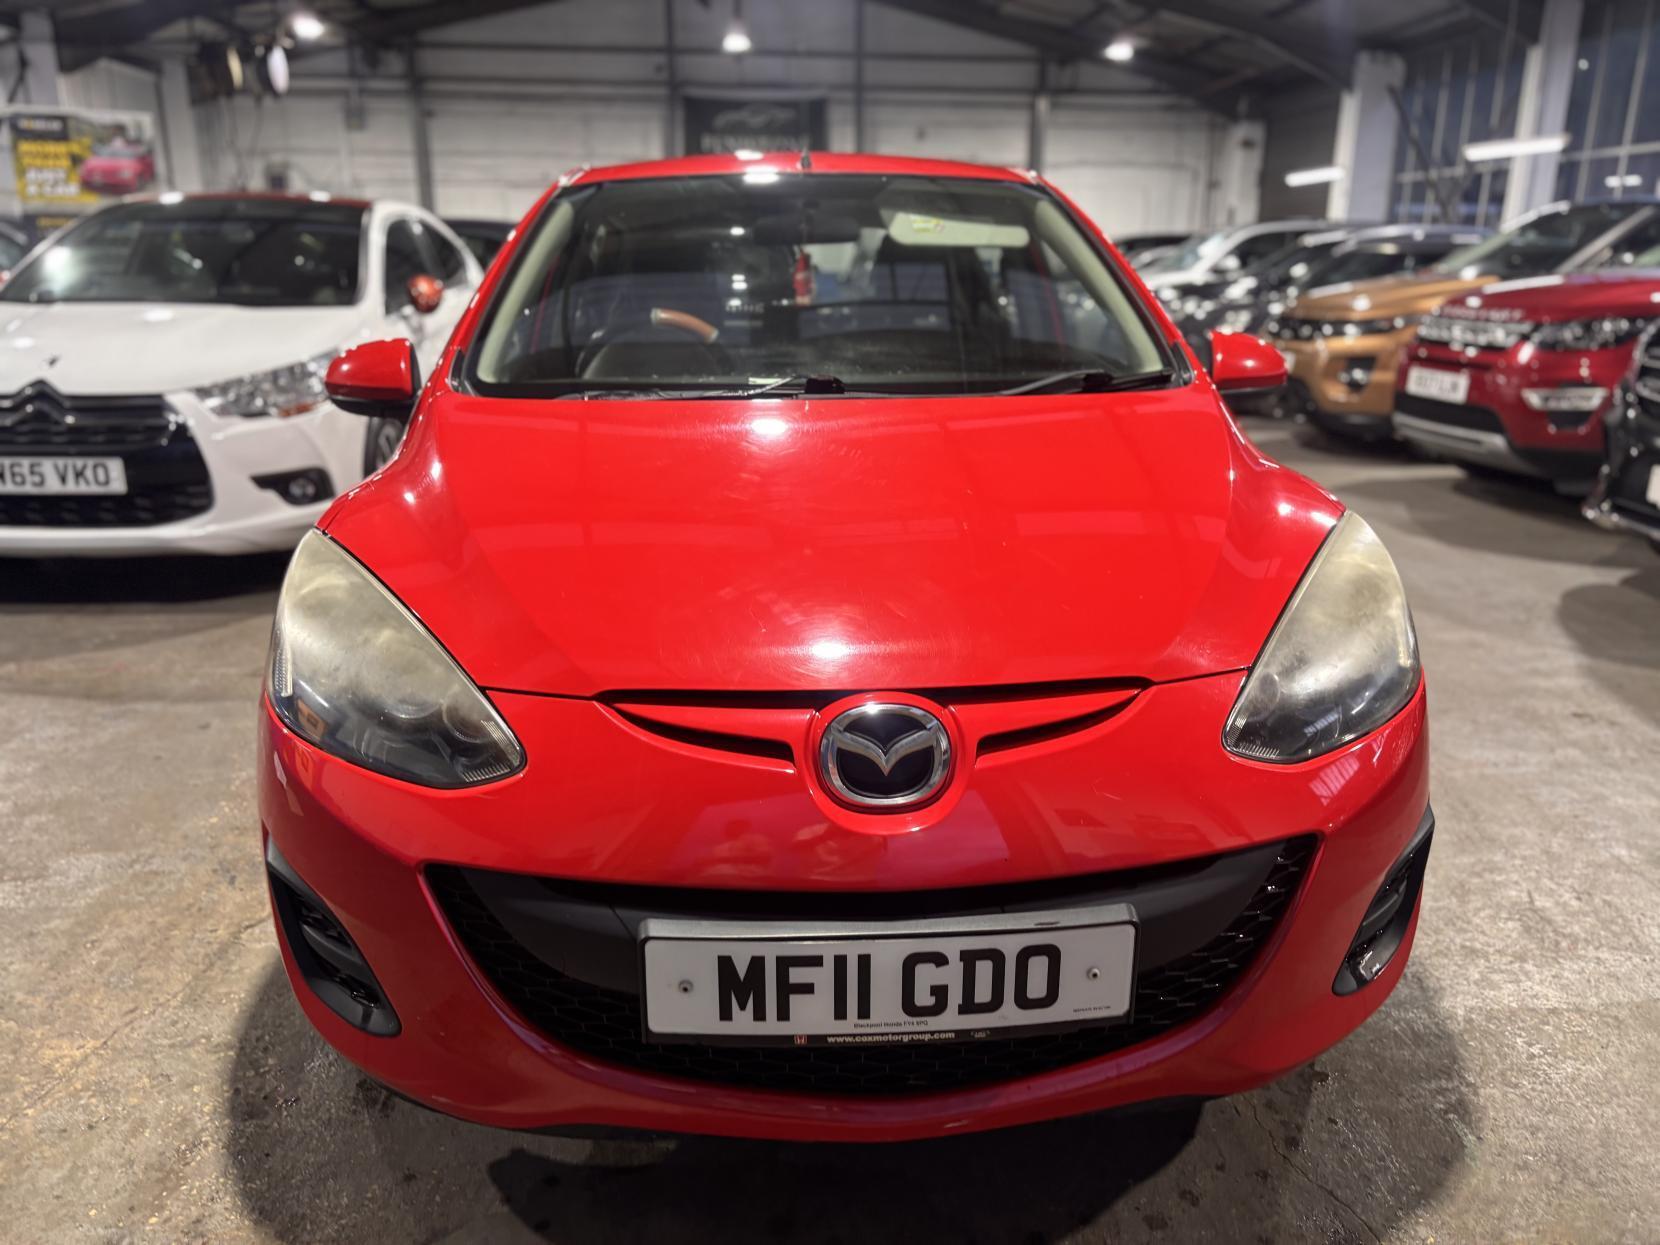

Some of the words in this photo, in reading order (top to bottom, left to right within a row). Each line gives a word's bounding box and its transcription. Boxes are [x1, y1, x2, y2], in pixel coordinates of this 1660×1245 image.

[53, 462, 110, 486] VKO
[717, 952, 872, 1022] MF11
[900, 943, 1062, 1018] GDO
[826, 1031, 956, 1044] www.coxmotorgroup.com
